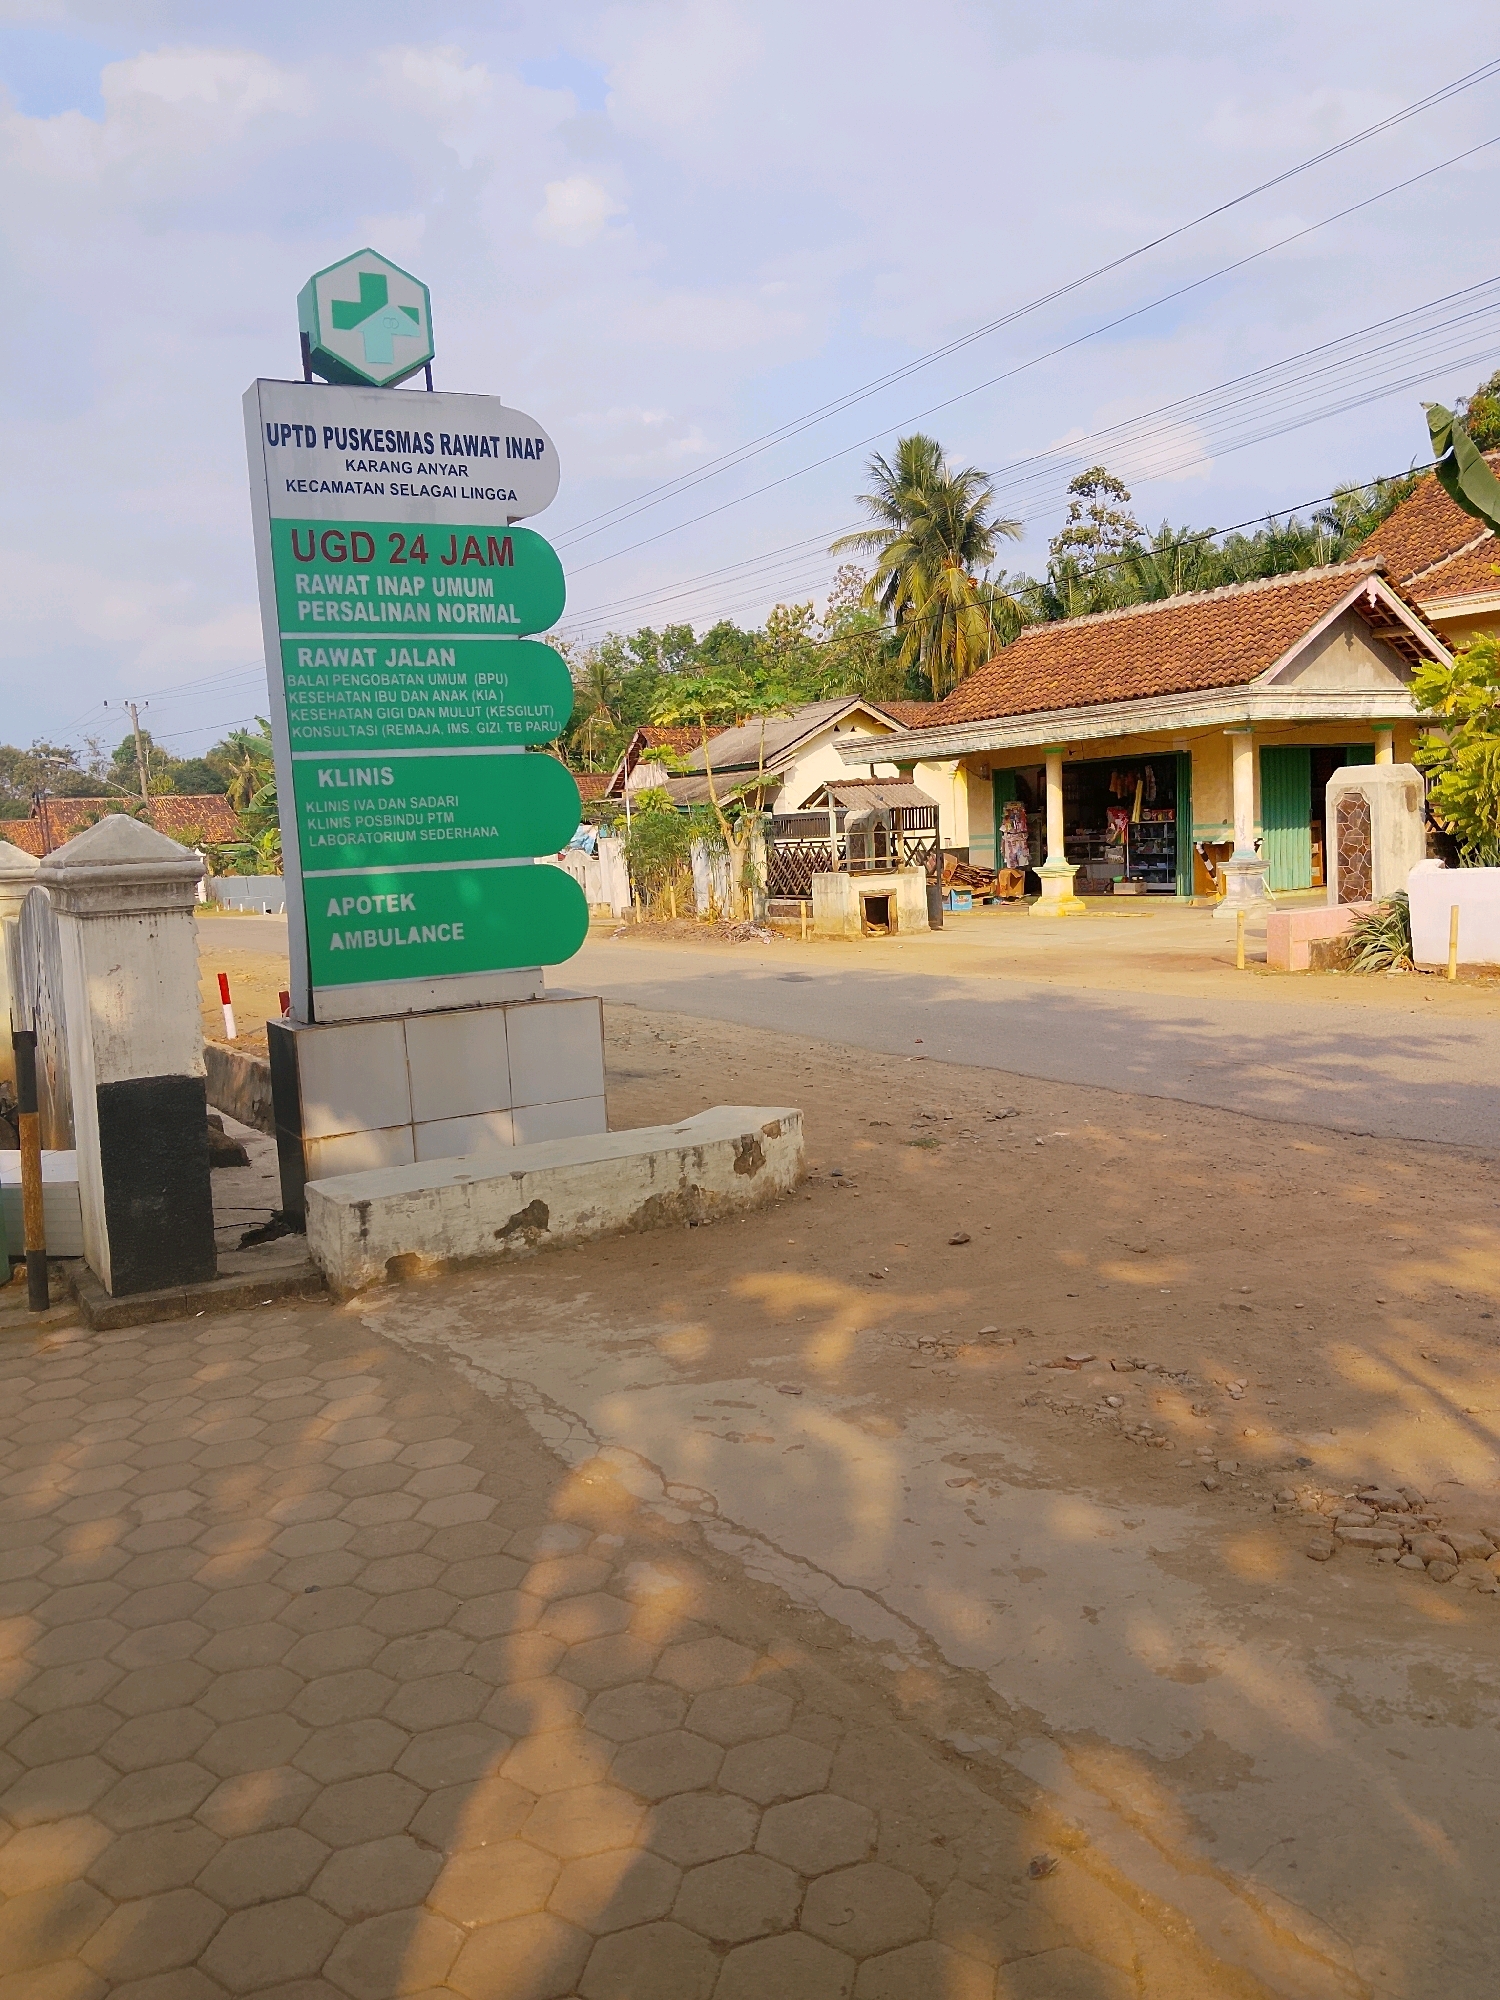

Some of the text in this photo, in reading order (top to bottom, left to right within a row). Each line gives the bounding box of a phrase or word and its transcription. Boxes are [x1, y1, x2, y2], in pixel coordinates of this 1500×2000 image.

[266, 422, 545, 460] UPTD PUSKESMAS RAWAT INAP
[346, 459, 469, 477] KARANG ANYAR
[286, 479, 518, 502] KECAMATAN SELAGAI LINGGA
[290, 528, 515, 566] UGD 24 JAM
[296, 574, 494, 598] RAWAT INAP UMUM
[298, 600, 521, 624] PERSALINAN NORMAL
[298, 648, 456, 667] RAWAT JALAN
[287, 673, 508, 687] BALAI PENGOBATAN UMUM (BPU)
[289, 690, 371, 704] KESEHATAN
[375, 690, 397, 702] IBU
[401, 690, 429, 702] DAN
[433, 689, 468, 701] ANAK
[291, 705, 554, 721] KESEHATAN GIGI DAN MULUT (KESGILUT)
[293, 724, 378, 738] KONSULTASI
[507, 722, 522, 732] TB
[526, 720, 562, 733] PARU)
[318, 767, 394, 788] KLINIS
[306, 796, 459, 813] KLINIS IVA DAN SADARI
[308, 812, 454, 830] KLINIS POSBINDU PTM
[310, 826, 498, 846] LABORATORIUM SEDERHANA
[326, 893, 416, 918] APOTEK
[330, 922, 464, 952] AMBULANCE
